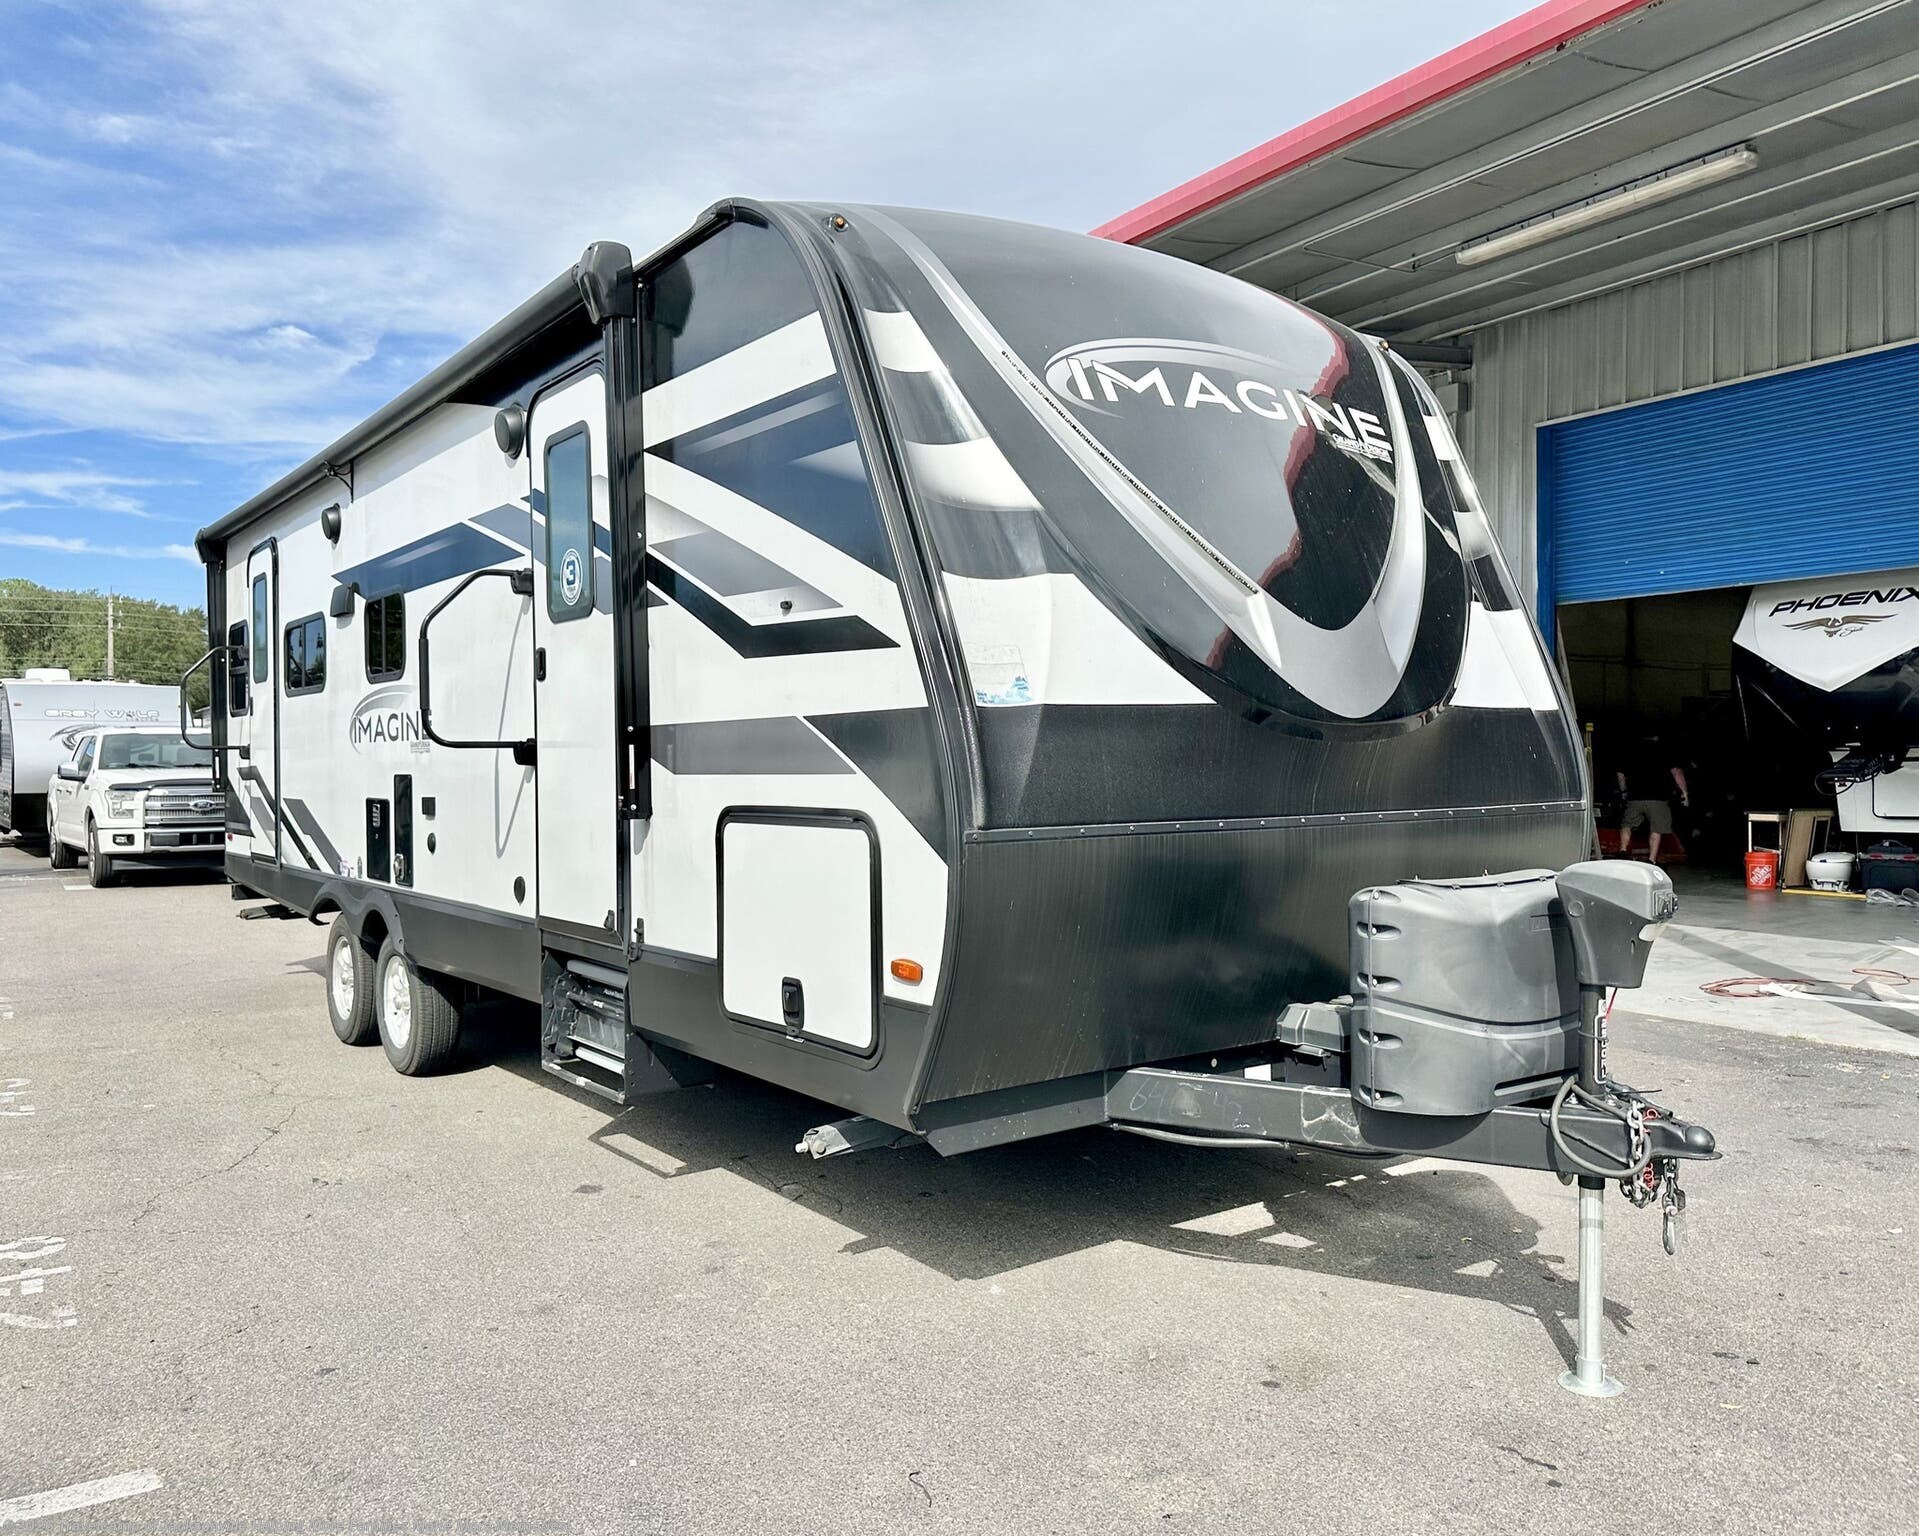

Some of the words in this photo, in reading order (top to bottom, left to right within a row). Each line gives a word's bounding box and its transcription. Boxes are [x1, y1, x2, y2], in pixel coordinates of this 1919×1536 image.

[1065, 357, 1393, 451] IMAGINE
[566, 559, 576, 586] 3
[1768, 586, 1919, 617] PHOENIX
[44, 708, 99, 719] GREY
